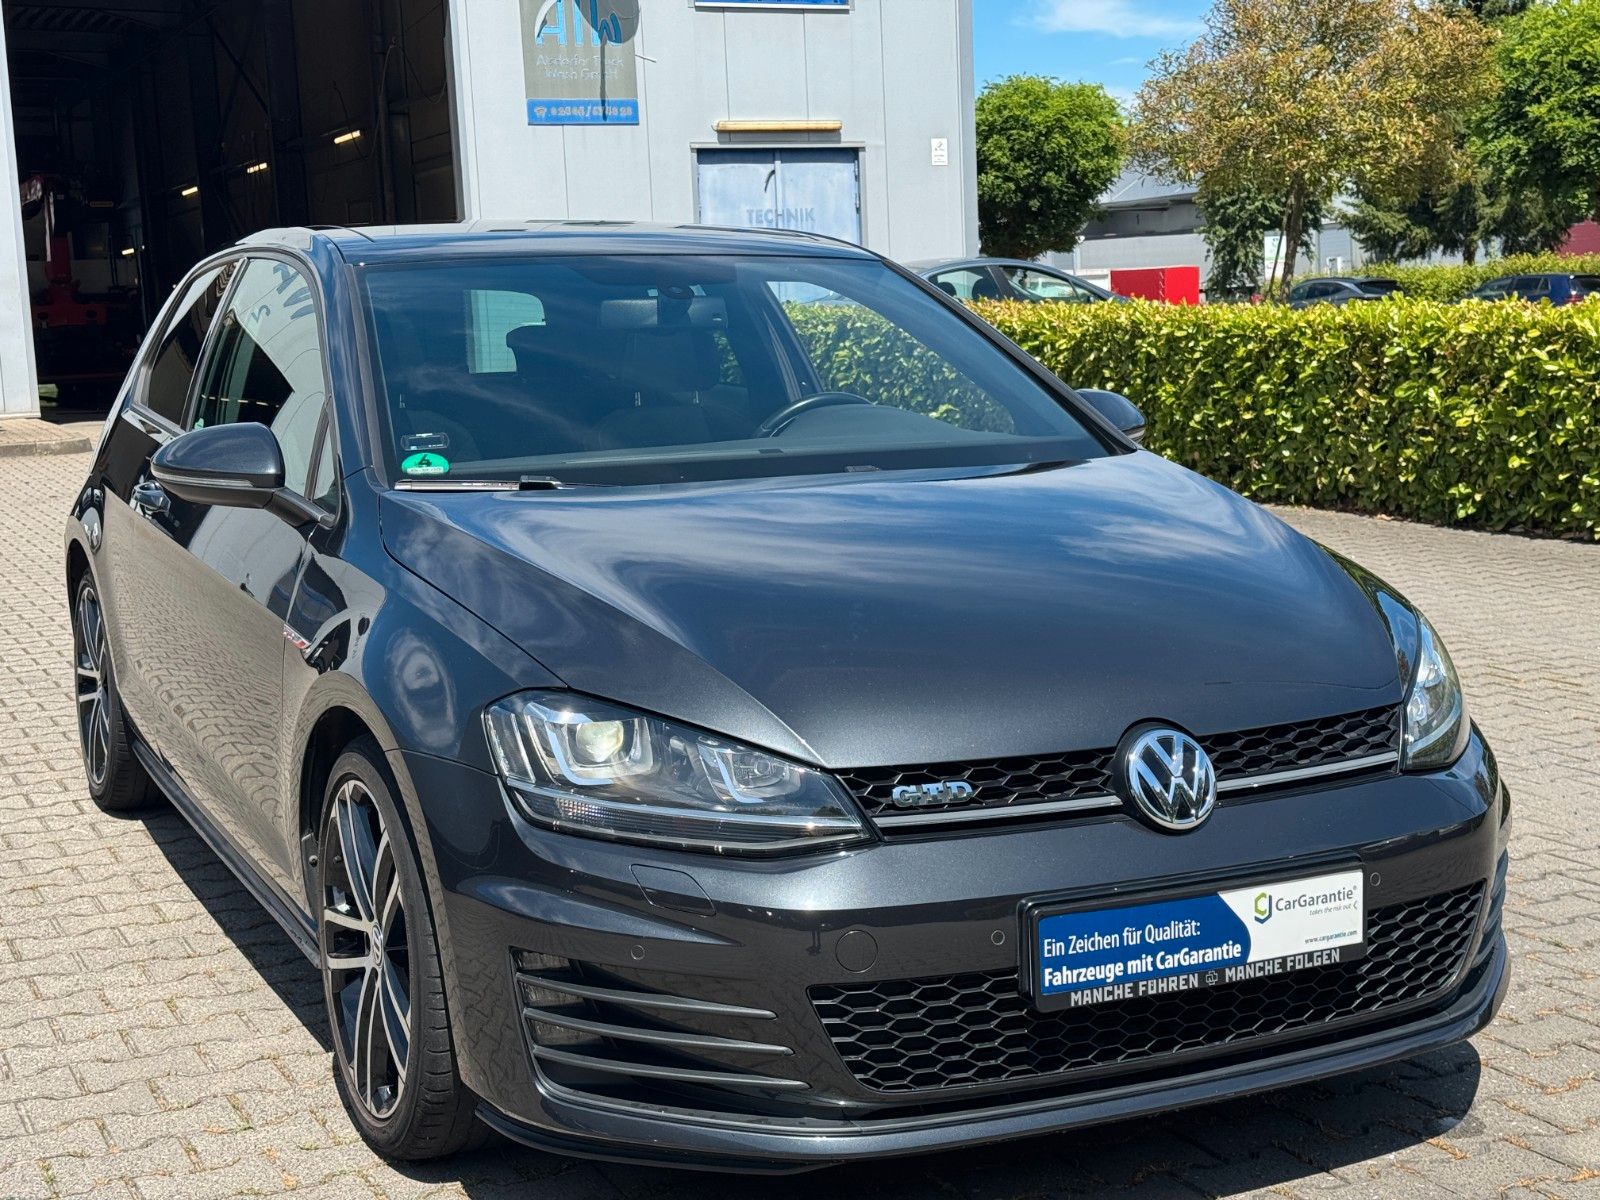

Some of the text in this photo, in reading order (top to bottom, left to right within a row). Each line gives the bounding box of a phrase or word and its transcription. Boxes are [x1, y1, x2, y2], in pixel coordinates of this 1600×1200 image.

[746, 207, 816, 225] TECHNIK
[892, 781, 974, 807] GTD
[1044, 919, 1200, 957] Ein Zeichen für Qualität:
[1044, 940, 1242, 987] Fahrzeuge mit CarGarantie
[1070, 982, 1133, 1007] MANCHE
[1225, 958, 1282, 982] MANCHE
[1286, 948, 1340, 971] FOLGEN
